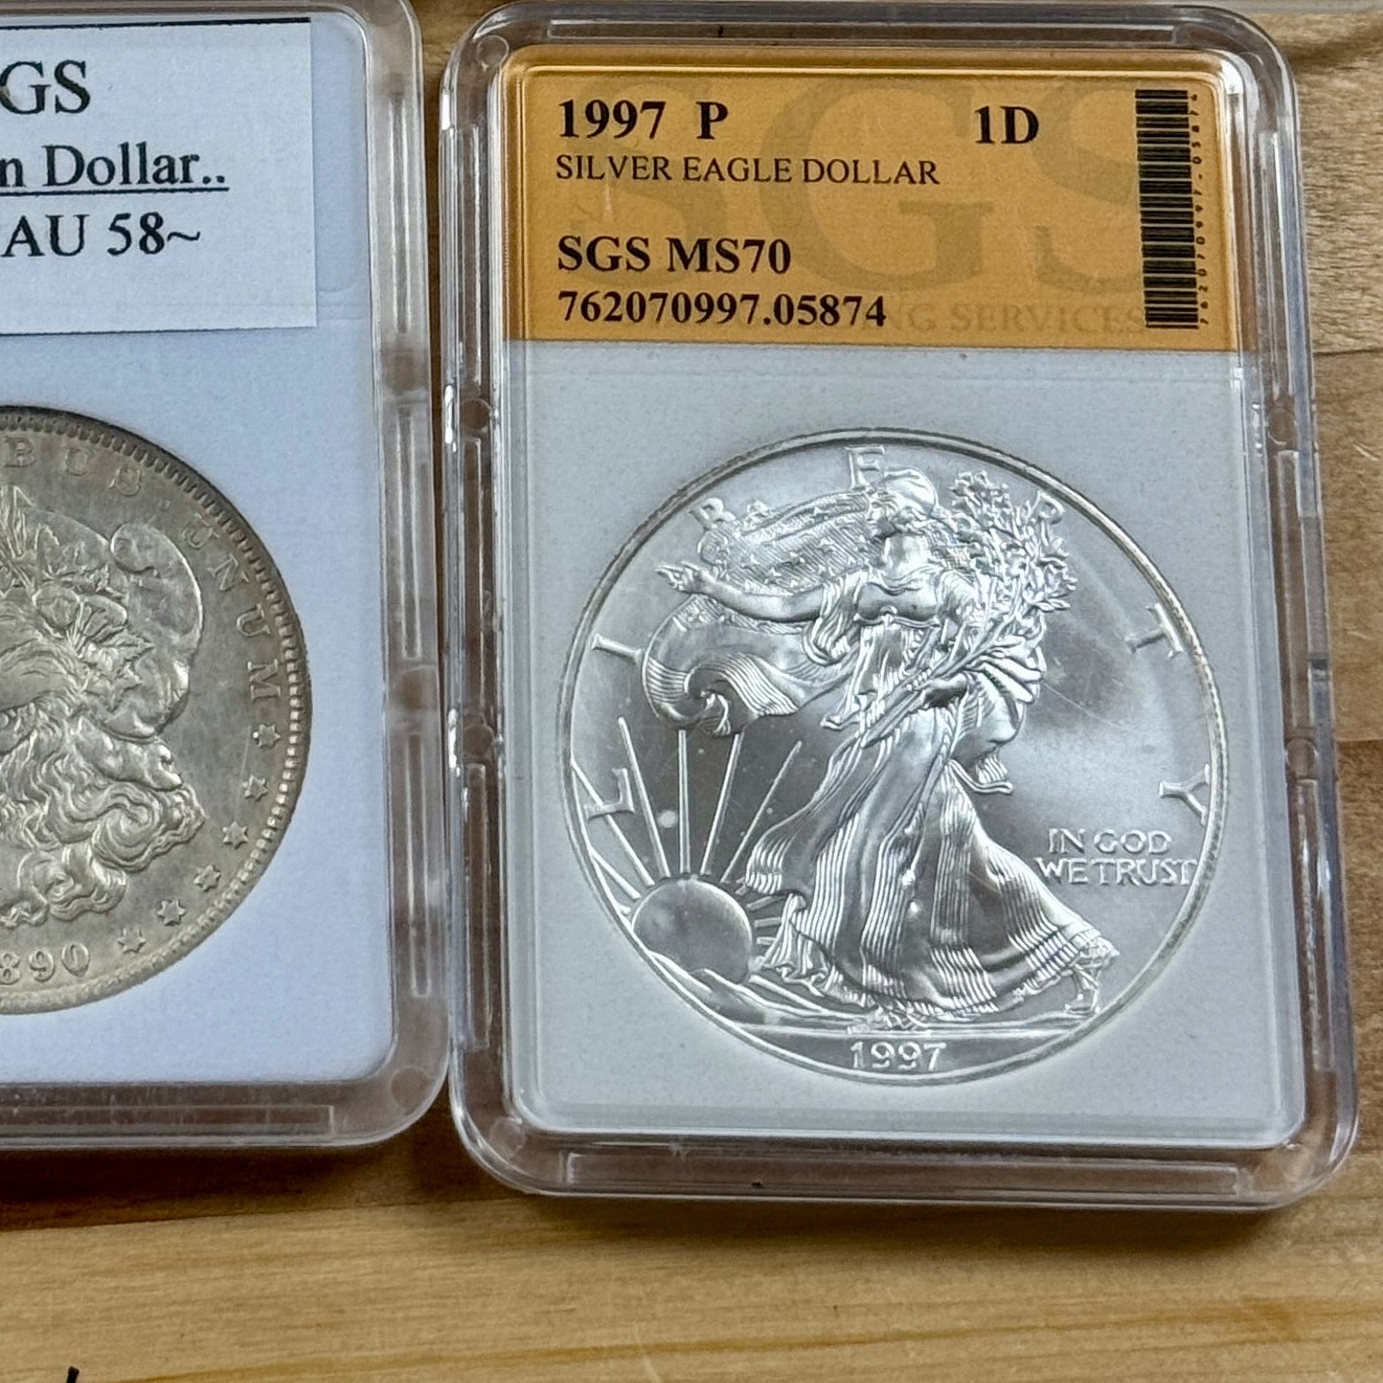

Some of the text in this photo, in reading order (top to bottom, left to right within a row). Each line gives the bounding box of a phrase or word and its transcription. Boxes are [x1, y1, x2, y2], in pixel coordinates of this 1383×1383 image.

[557, 98, 1040, 145] 1997 P 1D
[555, 153, 942, 187] SILVER EAGLE DOLLAR
[0, 213, 90, 259] AU
[556, 236, 793, 277] SGS MS70
[556, 289, 888, 330] 762070997.05874
[1048, 827, 1173, 855] IN GOD
[1033, 856, 1199, 886] WE TRUST
[848, 1041, 948, 1072] 1997
